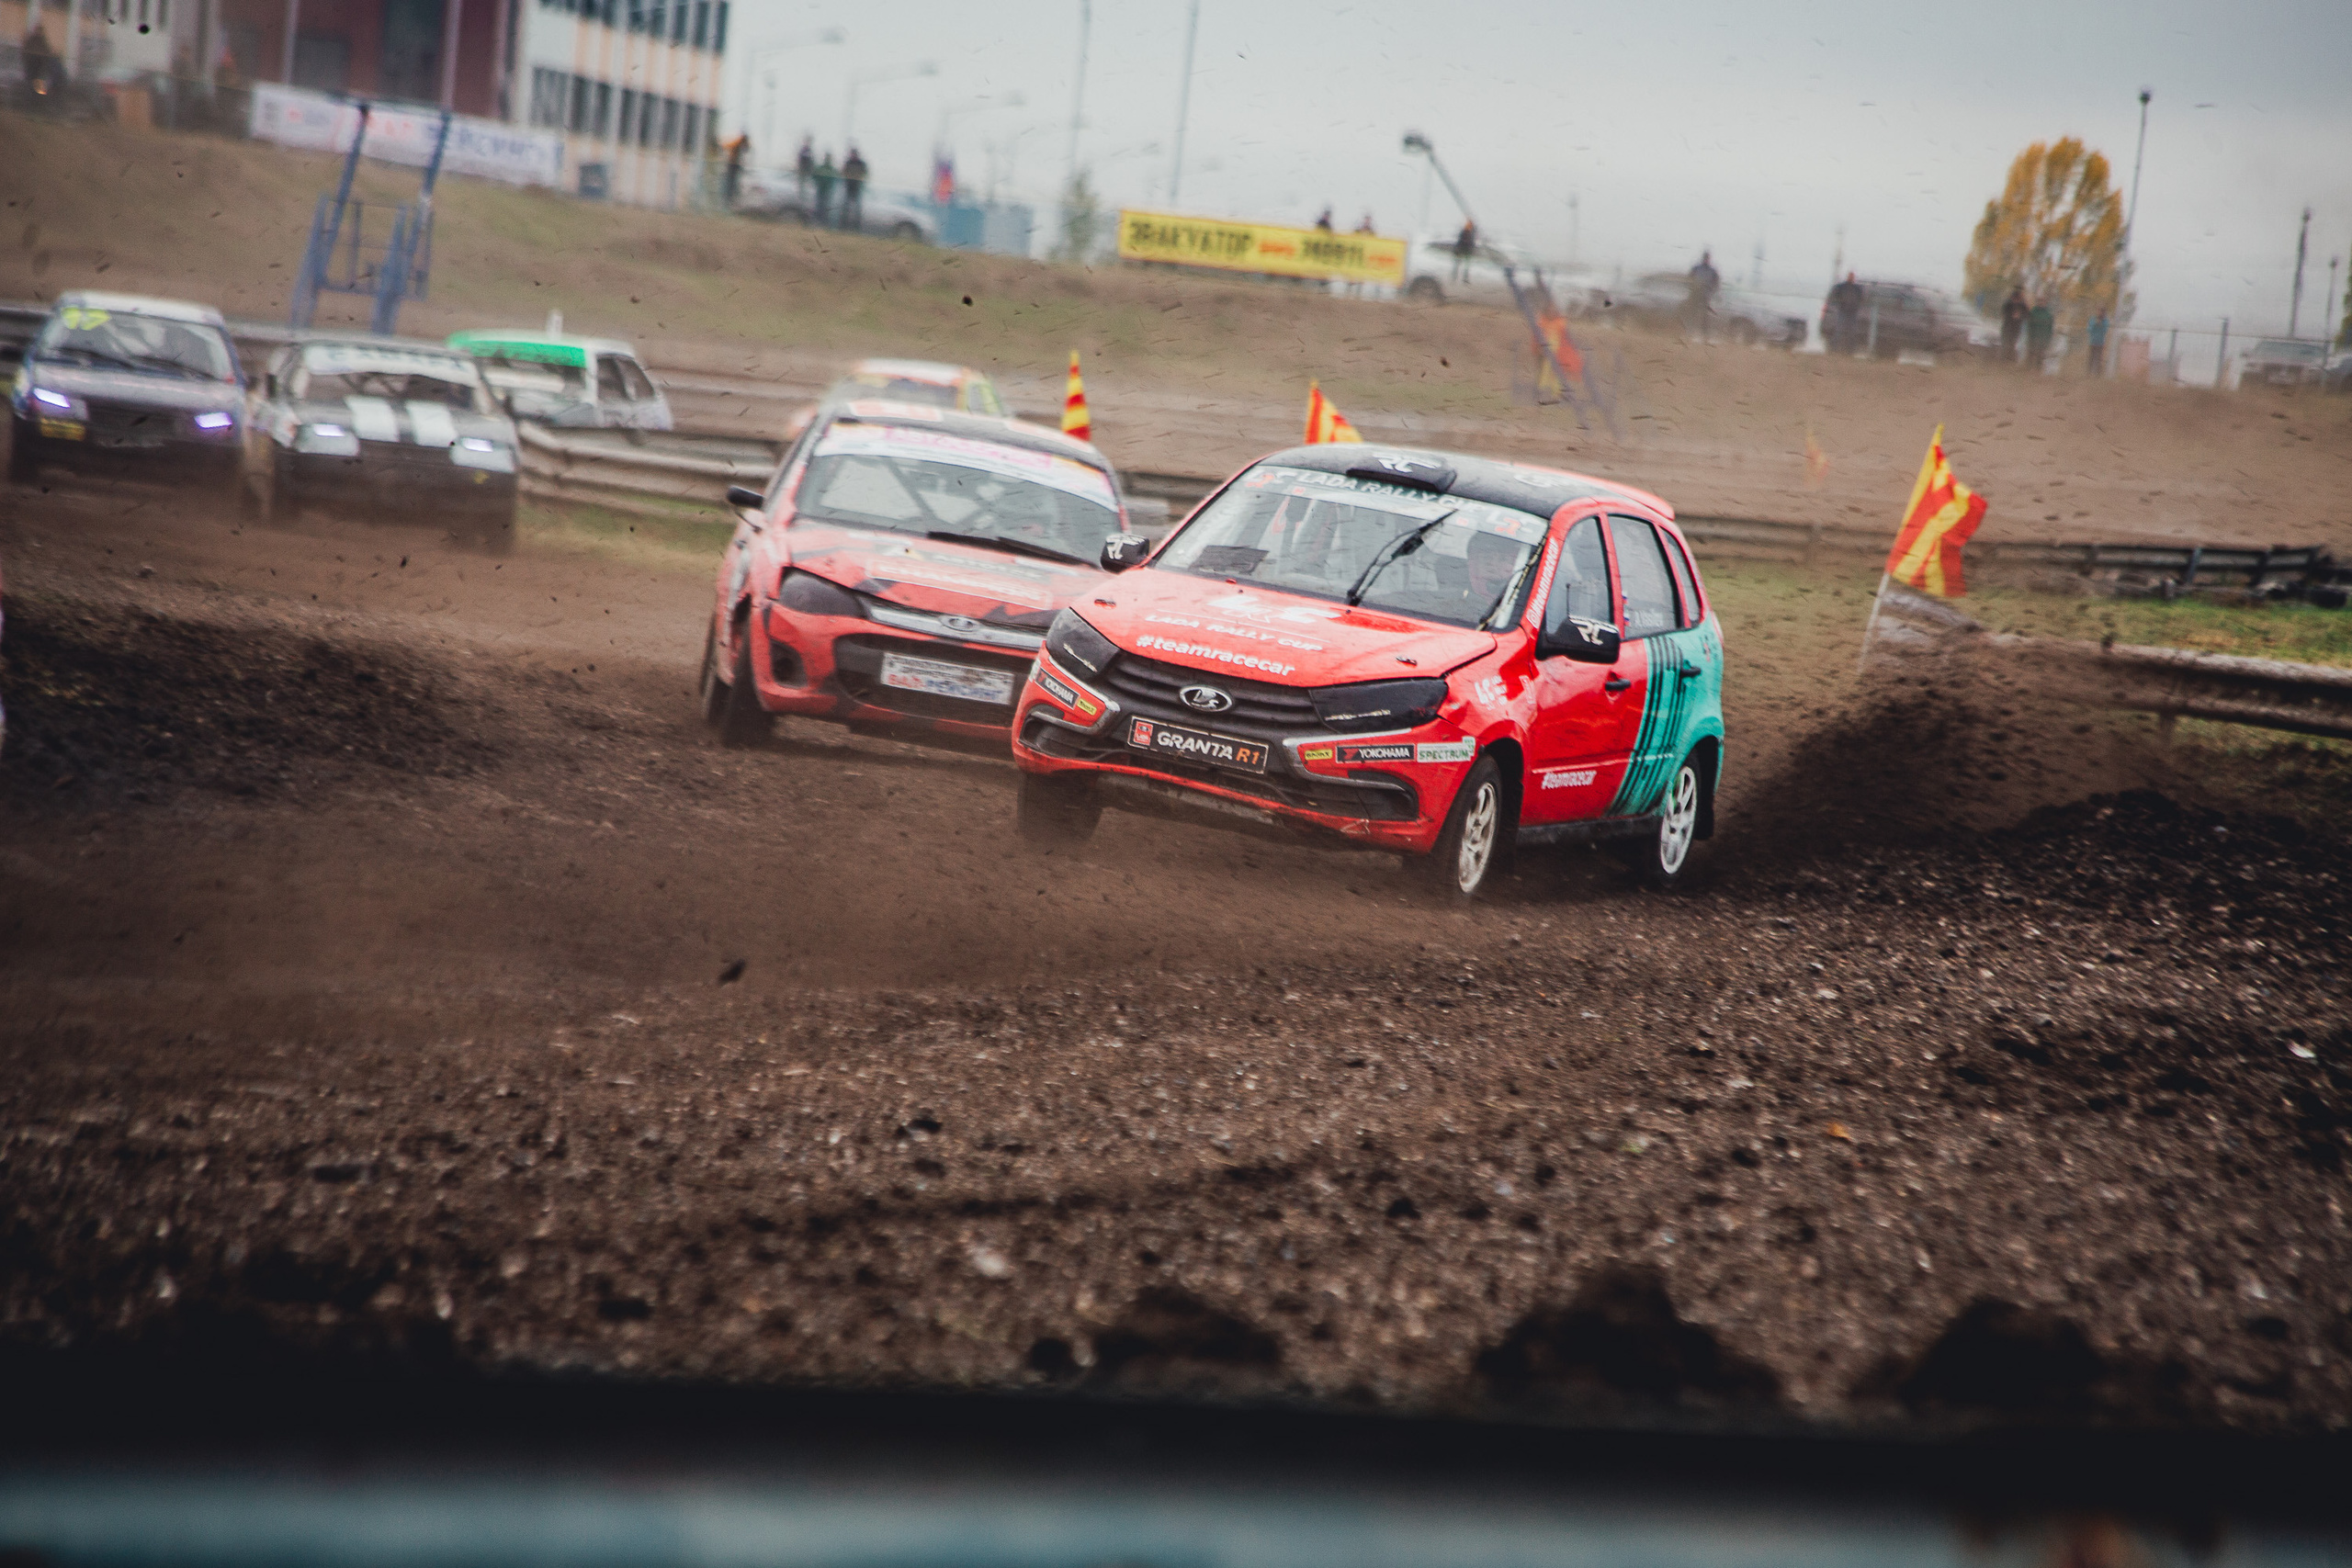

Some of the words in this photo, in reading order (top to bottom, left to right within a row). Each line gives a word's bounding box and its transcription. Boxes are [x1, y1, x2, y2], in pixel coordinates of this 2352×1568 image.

[1296, 472, 1358, 491] LADA
[1361, 481, 1438, 503] RALLY
[1145, 614, 1200, 628] LADA
[1206, 624, 1275, 641] RALLY
[1277, 637, 1323, 651] CUP
[1136, 634, 1295, 676] #teamracecar
[1157, 731, 1233, 761] GRANTA
[1236, 747, 1261, 765] R1
[1359, 746, 1410, 760] YOKOHAMA
[1419, 750, 1470, 761] SPECTRUM
